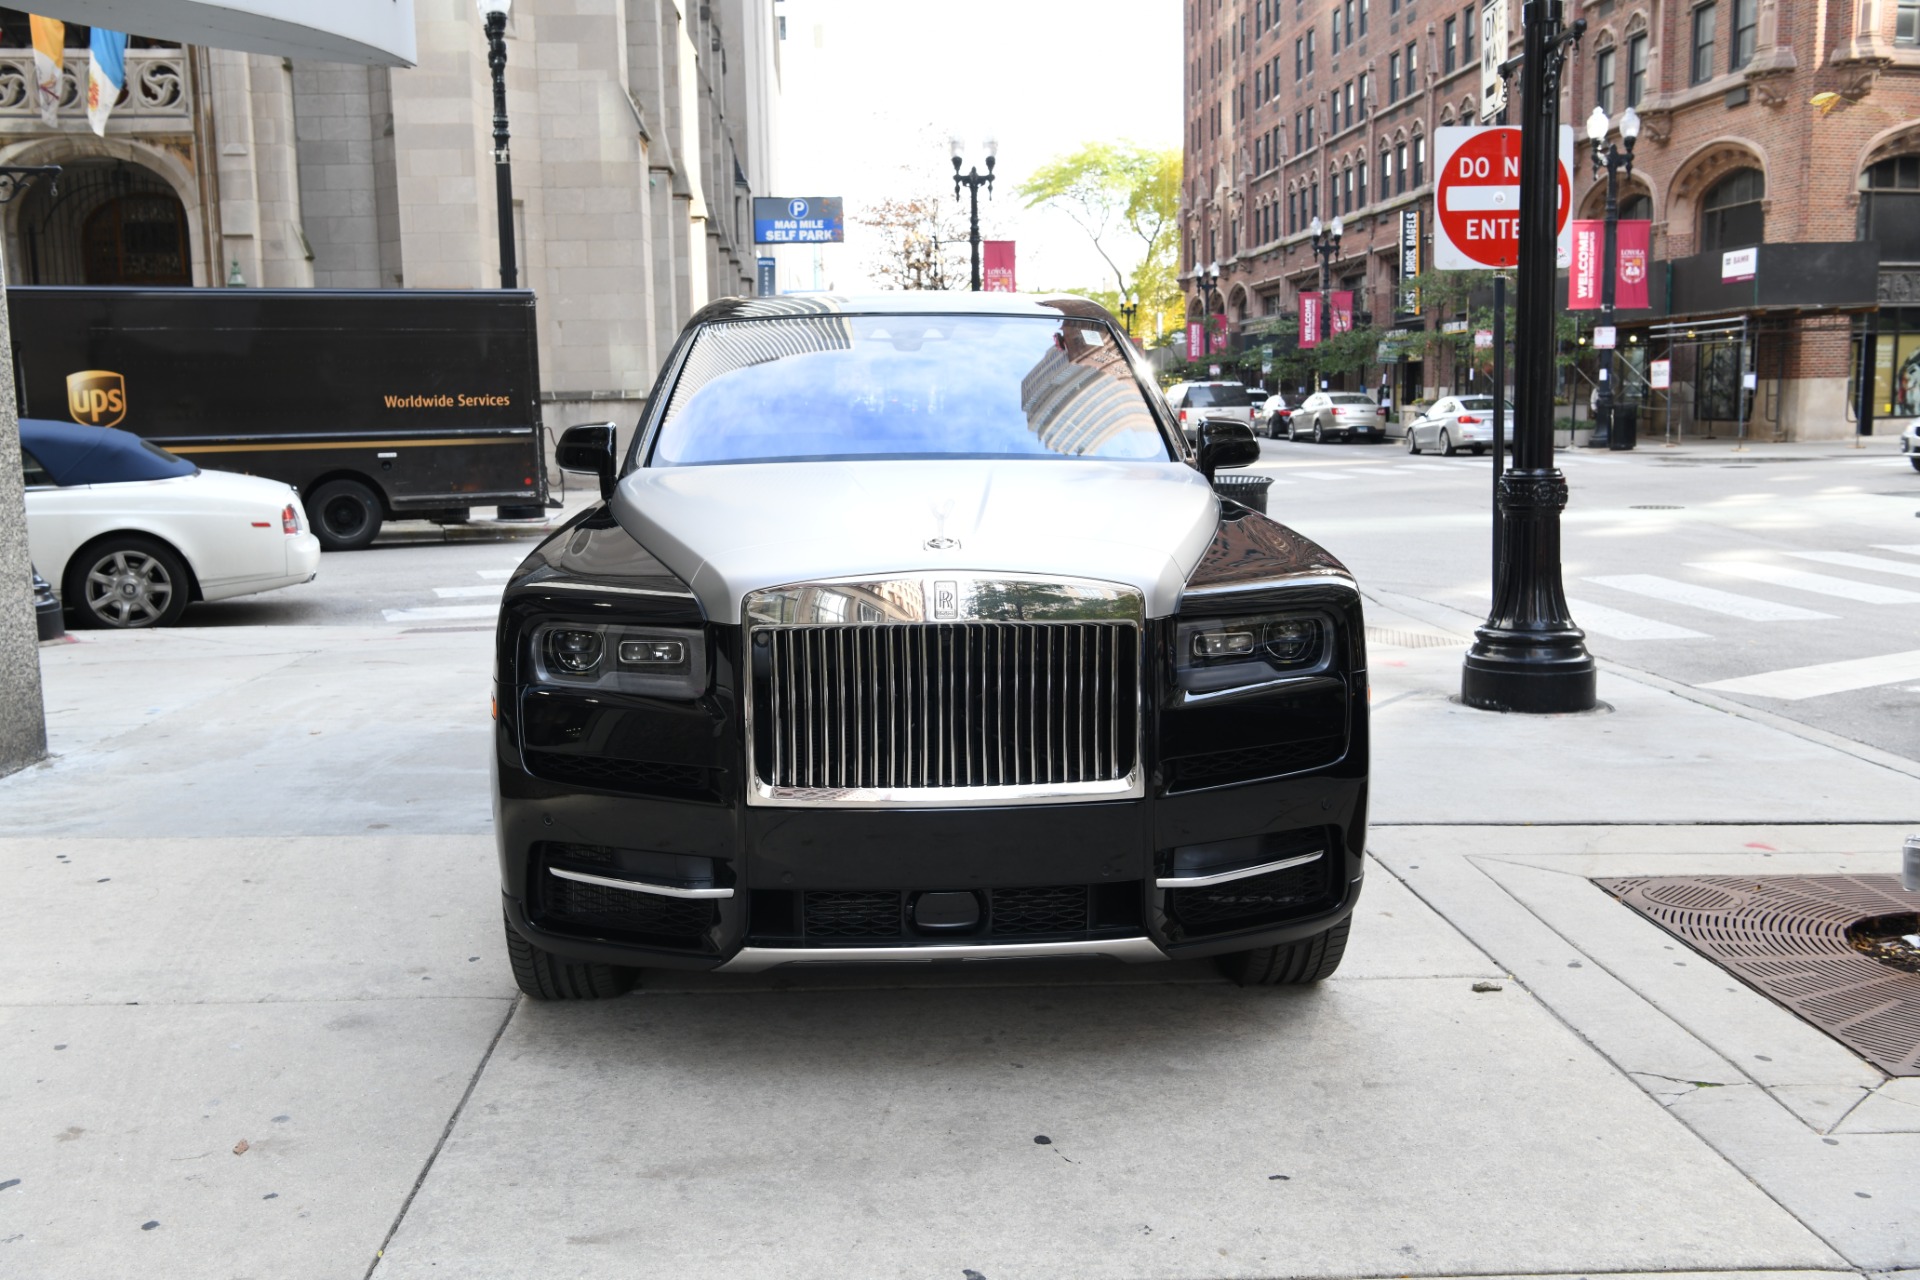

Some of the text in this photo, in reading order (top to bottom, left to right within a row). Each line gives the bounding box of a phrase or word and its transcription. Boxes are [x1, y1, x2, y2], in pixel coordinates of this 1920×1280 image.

[1485, 6, 1504, 42] ONE
[1484, 37, 1505, 73] WAY
[1459, 156, 1490, 178] DO
[793, 201, 805, 216] P
[765, 229, 833, 241] SELF PARK
[774, 219, 824, 229] MAG MILE
[1406, 212, 1417, 247] BAGELS
[1466, 218, 1520, 240] ENTE
[1577, 231, 1589, 298] WELCOME
[1304, 298, 1312, 341] WELCOME
[72, 388, 123, 422] ups
[384, 393, 511, 408] Worldwide Services
